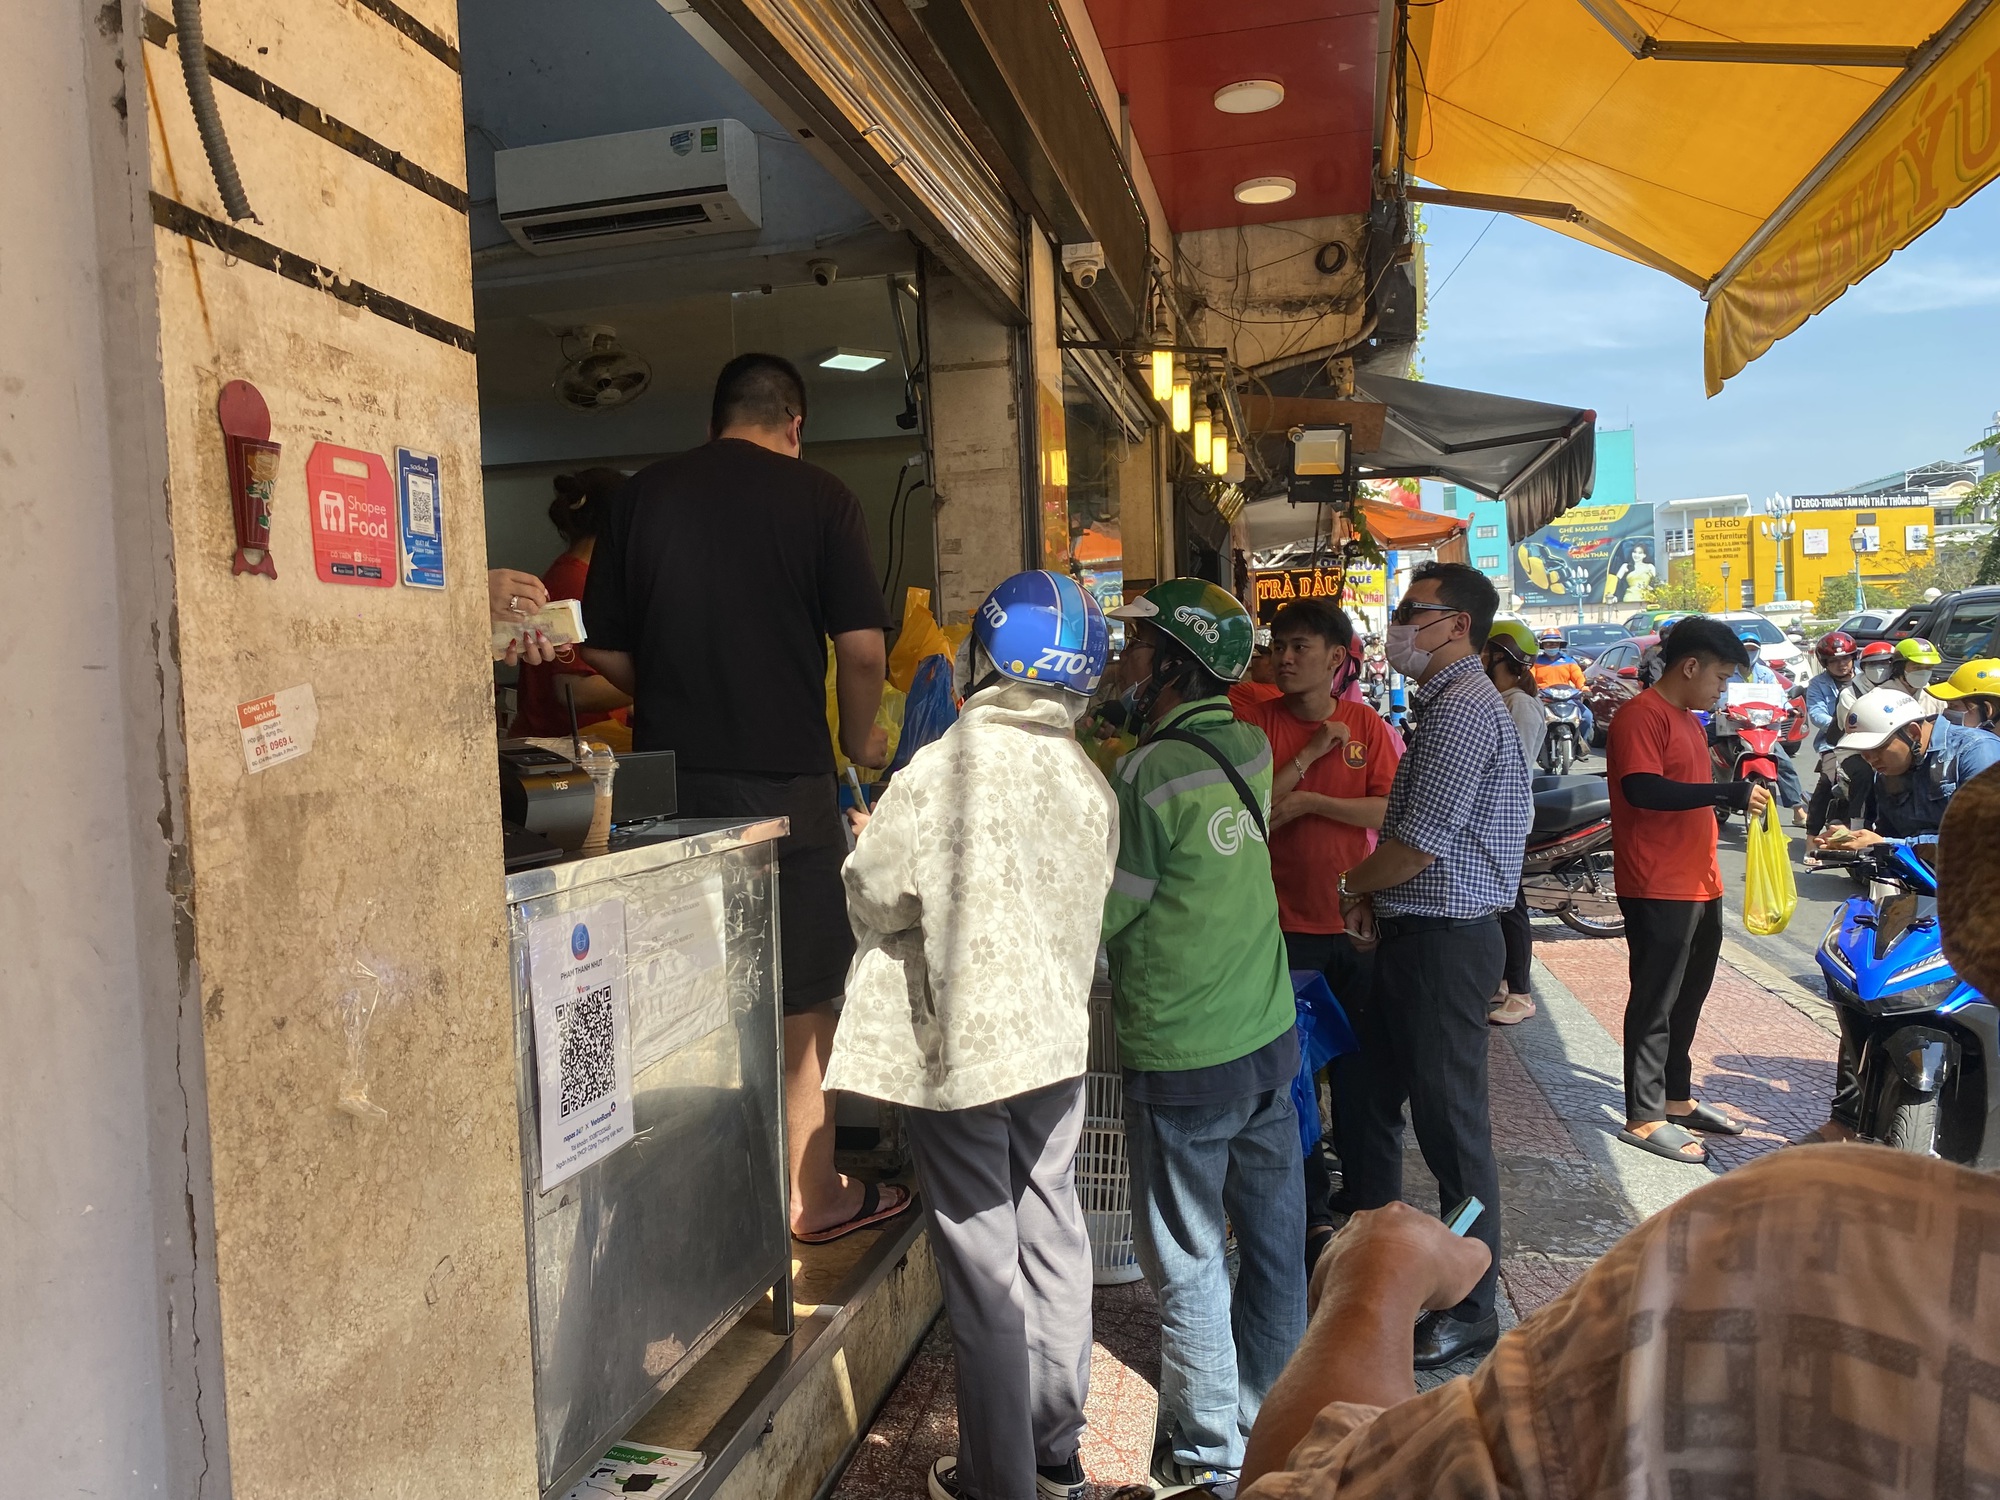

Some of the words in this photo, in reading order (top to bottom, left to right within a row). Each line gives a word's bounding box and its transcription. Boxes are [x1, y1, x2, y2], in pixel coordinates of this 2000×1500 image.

[410, 463, 429, 474] sodexo
[348, 495, 387, 516] Shopee
[1843, 495, 1857, 507] TÂM
[1911, 496, 1928, 505] MINH
[348, 512, 388, 538] Food
[1700, 533, 1719, 541] Smart
[1719, 532, 1747, 540] Furniture
[1258, 573, 1296, 599] TRÀ
[982, 597, 1008, 629] ZTO
[1174, 605, 1220, 644] Grab
[243, 704, 260, 715] CÔNG
[254, 709, 275, 722] HOÀNG
[255, 744, 268, 757] ĐT:
[1350, 745, 1363, 760] K
[1207, 789, 1272, 856] Gra
[575, 963, 590, 974] THANH
